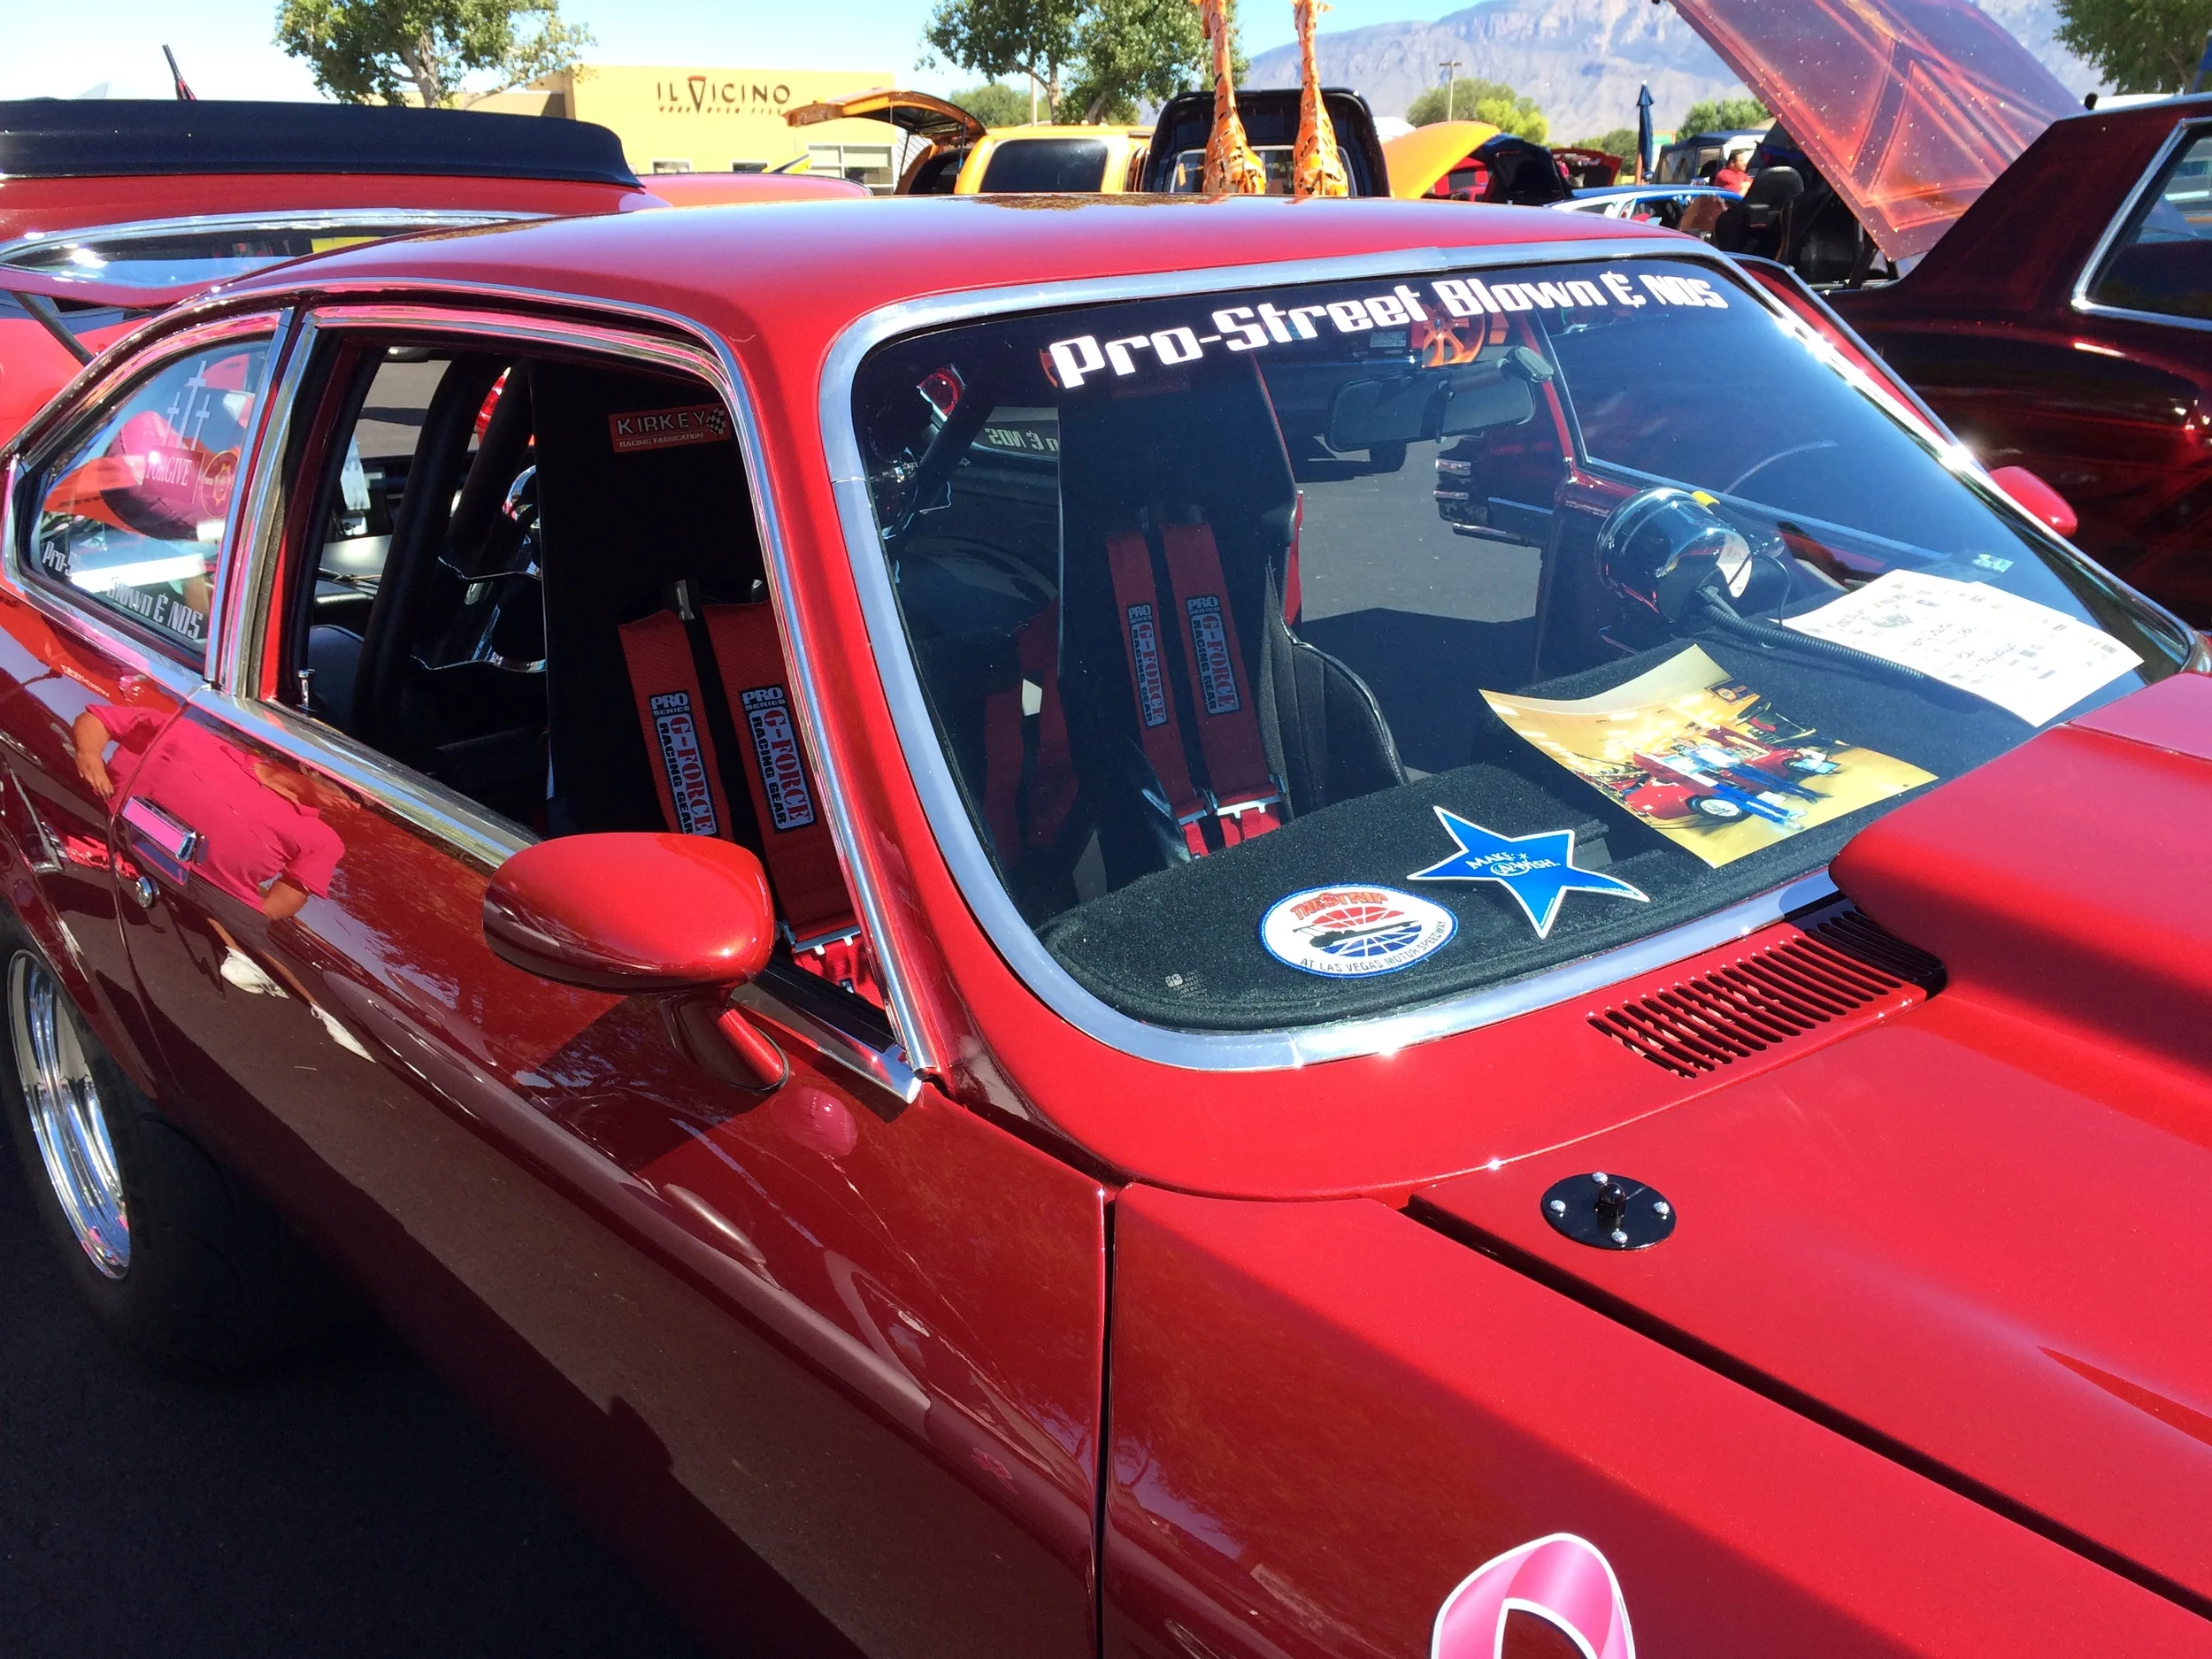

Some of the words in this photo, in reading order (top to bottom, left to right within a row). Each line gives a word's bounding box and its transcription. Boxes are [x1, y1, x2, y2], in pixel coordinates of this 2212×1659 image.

[657, 81, 679, 102] IL
[687, 75, 790, 113] VICINO
[1048, 284, 1430, 389] Pro-Street
[1431, 277, 1609, 318] Blown
[1638, 273, 1729, 310] NOS
[617, 411, 706, 435] KIRKEY
[619, 438, 651, 448] RACING
[653, 432, 704, 445] FABRICATION
[167, 600, 204, 641] NOS
[1128, 604, 1151, 619] PRO
[1187, 596, 1219, 611] PRO
[1133, 629, 1146, 684] RACING
[1141, 687, 1153, 723] GEAR
[1139, 624, 1165, 721] G-FORCE
[1193, 619, 1210, 672] RACING
[1203, 674, 1217, 710] GEAR
[1202, 615, 1236, 708] G-FORCE
[650, 692, 688, 710] PRO
[653, 705, 690, 717] SERIES
[741, 686, 784, 705] PRO
[744, 698, 786, 711] SERIES
[658, 722, 683, 787] RACING
[676, 791, 694, 835] GEAR
[670, 716, 715, 833] G-FORCE
[751, 716, 775, 780] RACING
[768, 782, 787, 825] GEAR
[764, 710, 812, 822] G-FORCE
[1300, 957, 1314, 970] AT
[1319, 962, 1343, 972] LAS
[1345, 956, 1384, 972] VEGAS
[1383, 947, 1421, 966] MOTOR
[1417, 919, 1448, 951] SPEEDWAY
